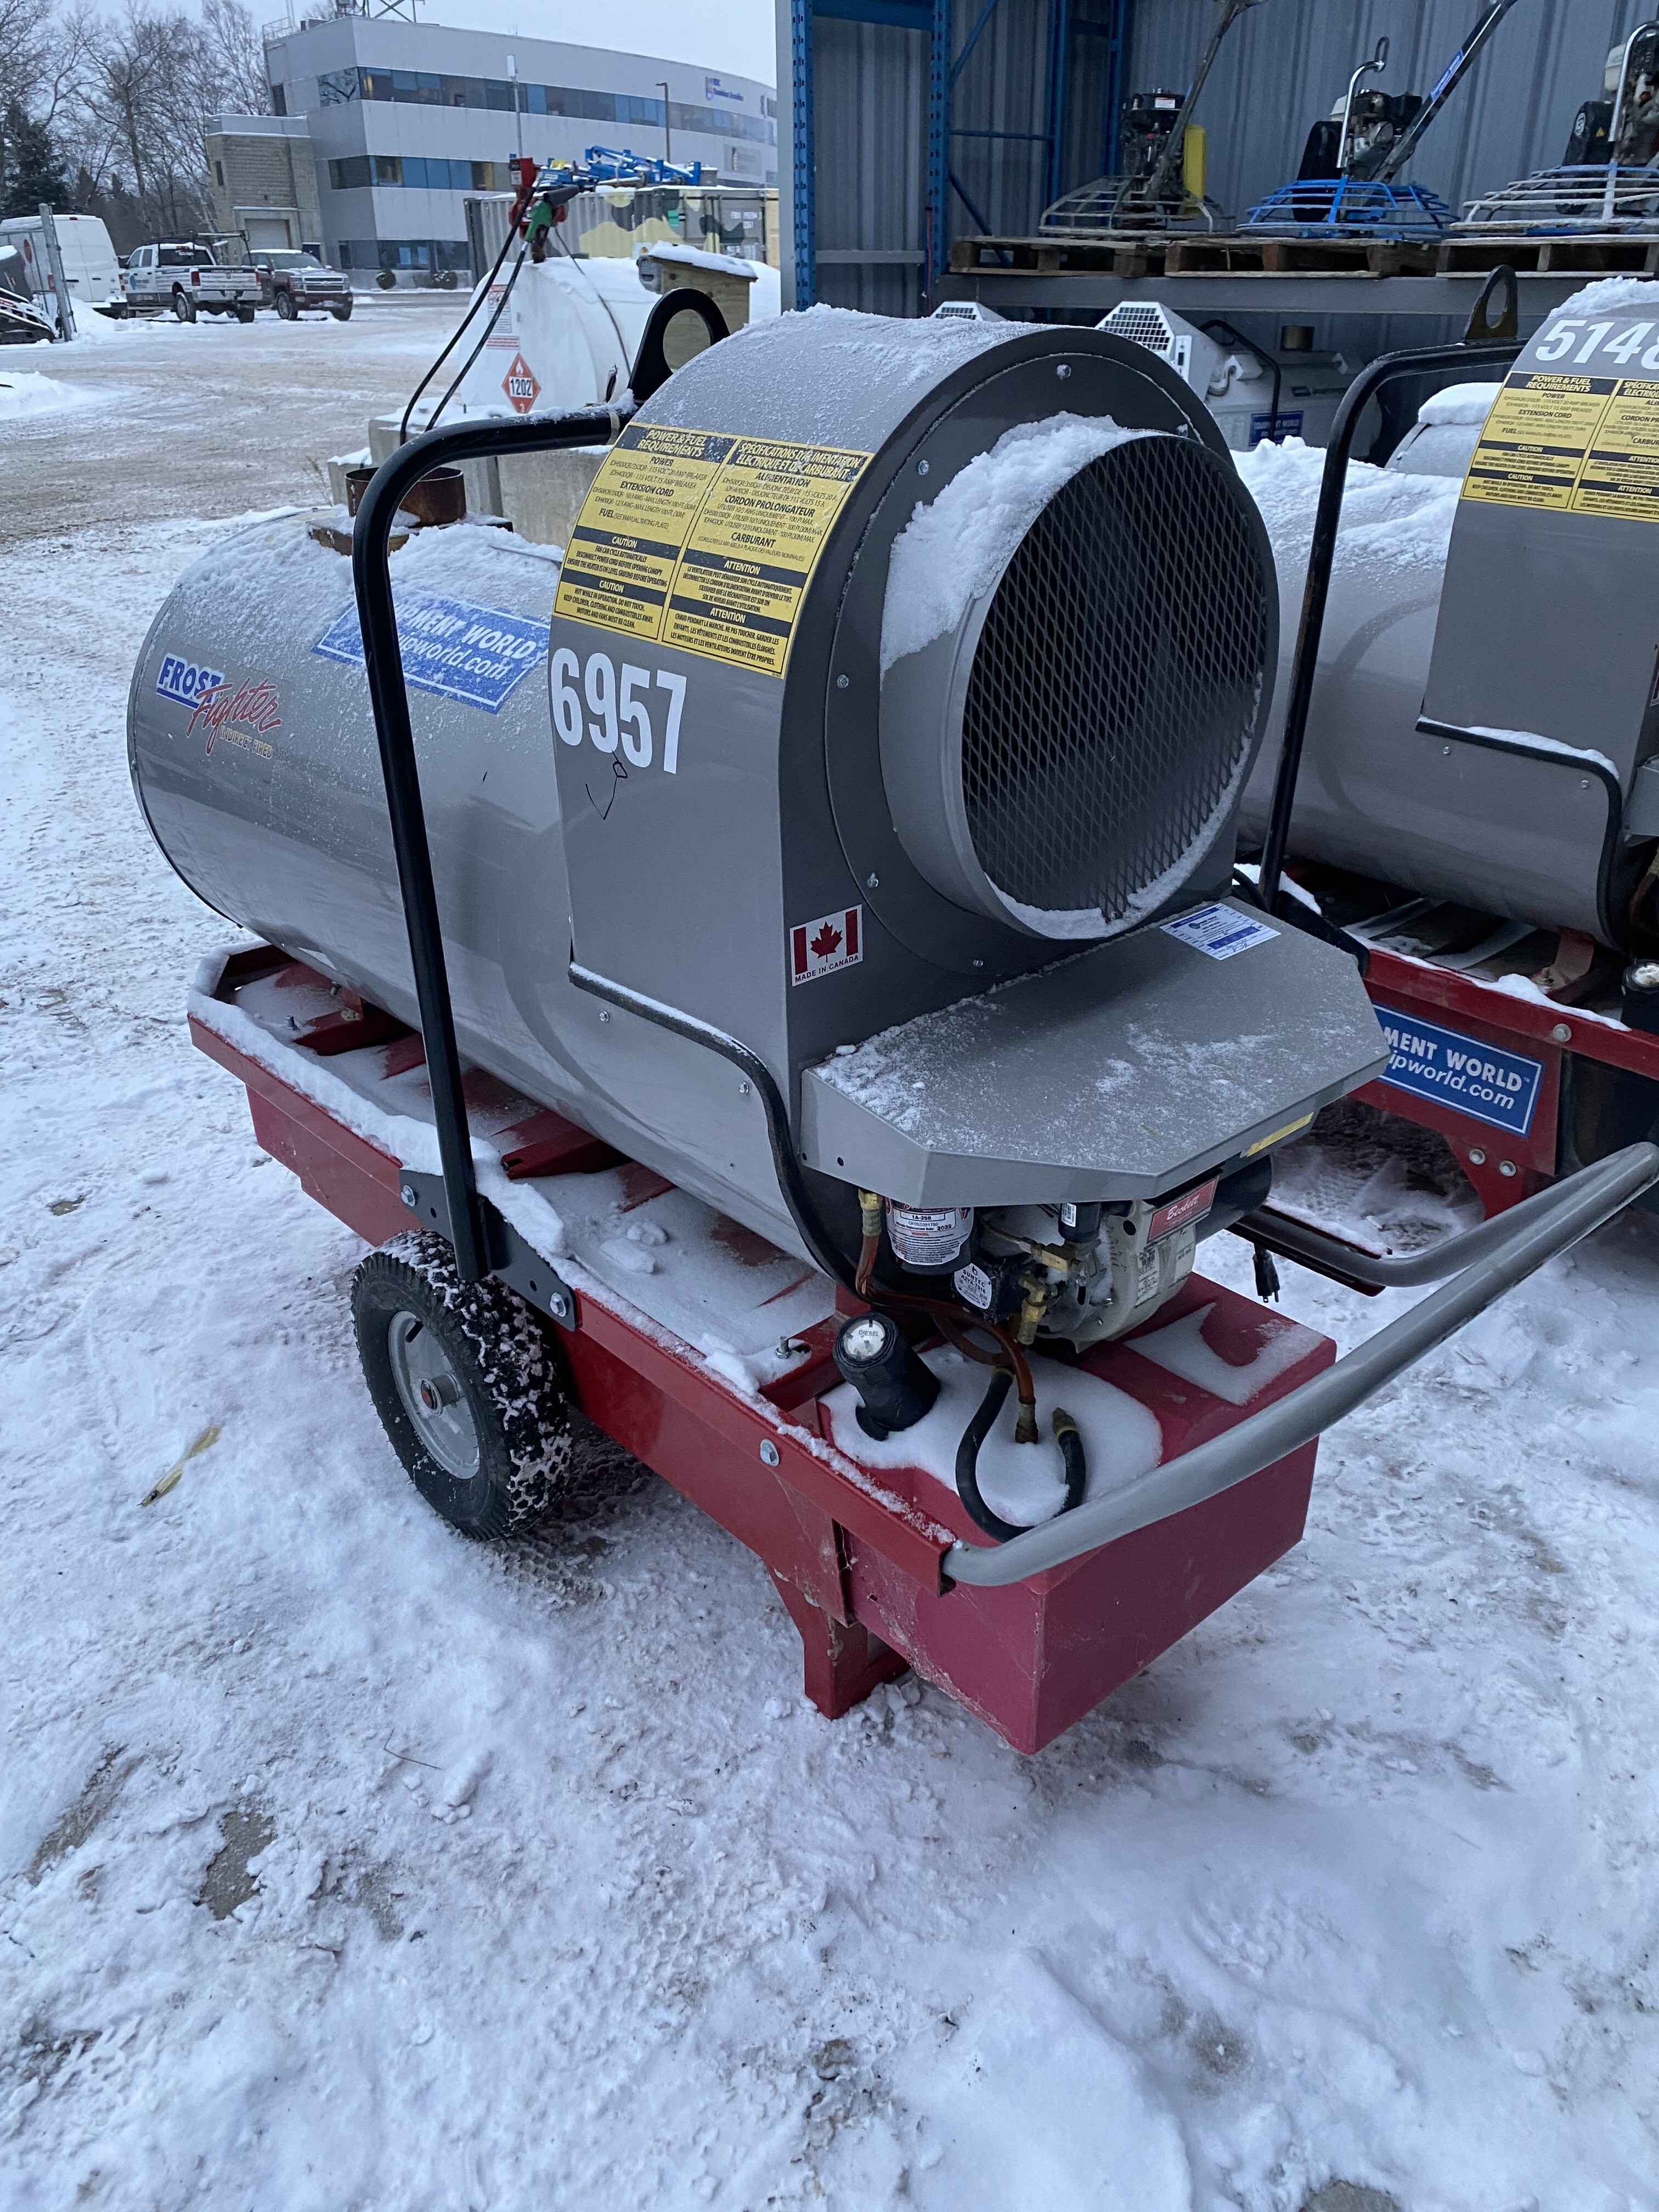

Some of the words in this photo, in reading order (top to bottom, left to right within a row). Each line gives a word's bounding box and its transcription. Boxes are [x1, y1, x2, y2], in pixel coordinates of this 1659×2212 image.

[510, 378, 533, 396] 1202
[1526, 381, 1592, 392] REQUIREMENTS
[1532, 375, 1563, 383] POWER
[645, 429, 680, 442] POWER
[675, 433, 687, 443] &
[683, 434, 710, 446] FUEL
[636, 439, 706, 457] REQUIREMENTS
[648, 456, 675, 467] POWER
[777, 459, 792, 471] ET
[798, 462, 850, 479] CARBURANT
[619, 481, 656, 494] EXTENSION
[654, 487, 675, 497] CORD
[1618, 486, 1652, 494] ATTENTION
[598, 508, 616, 518] FUEL
[724, 494, 758, 507] CORDON
[754, 500, 816, 517] PROLONGATEUR
[611, 535, 638, 549] CAUTION
[730, 532, 776, 548] CARBURANT
[723, 560, 761, 575] ATTENTION
[599, 579, 624, 593] CAUTION
[709, 607, 746, 624] ATTENTION
[461, 624, 537, 659] WORLD
[159, 657, 221, 704] FROST
[186, 676, 281, 755] Fighter
[551, 648, 687, 774] 6957
[219, 725, 252, 751] INDIRECT
[252, 738, 273, 759] FIRED
[795, 969, 816, 983] MADE
[829, 955, 859, 970] CANADA
[1447, 1048, 1522, 1092] WORLD
[1166, 1193, 1200, 1221] Beckett
[963, 1269, 985, 1288] SUNTEC
